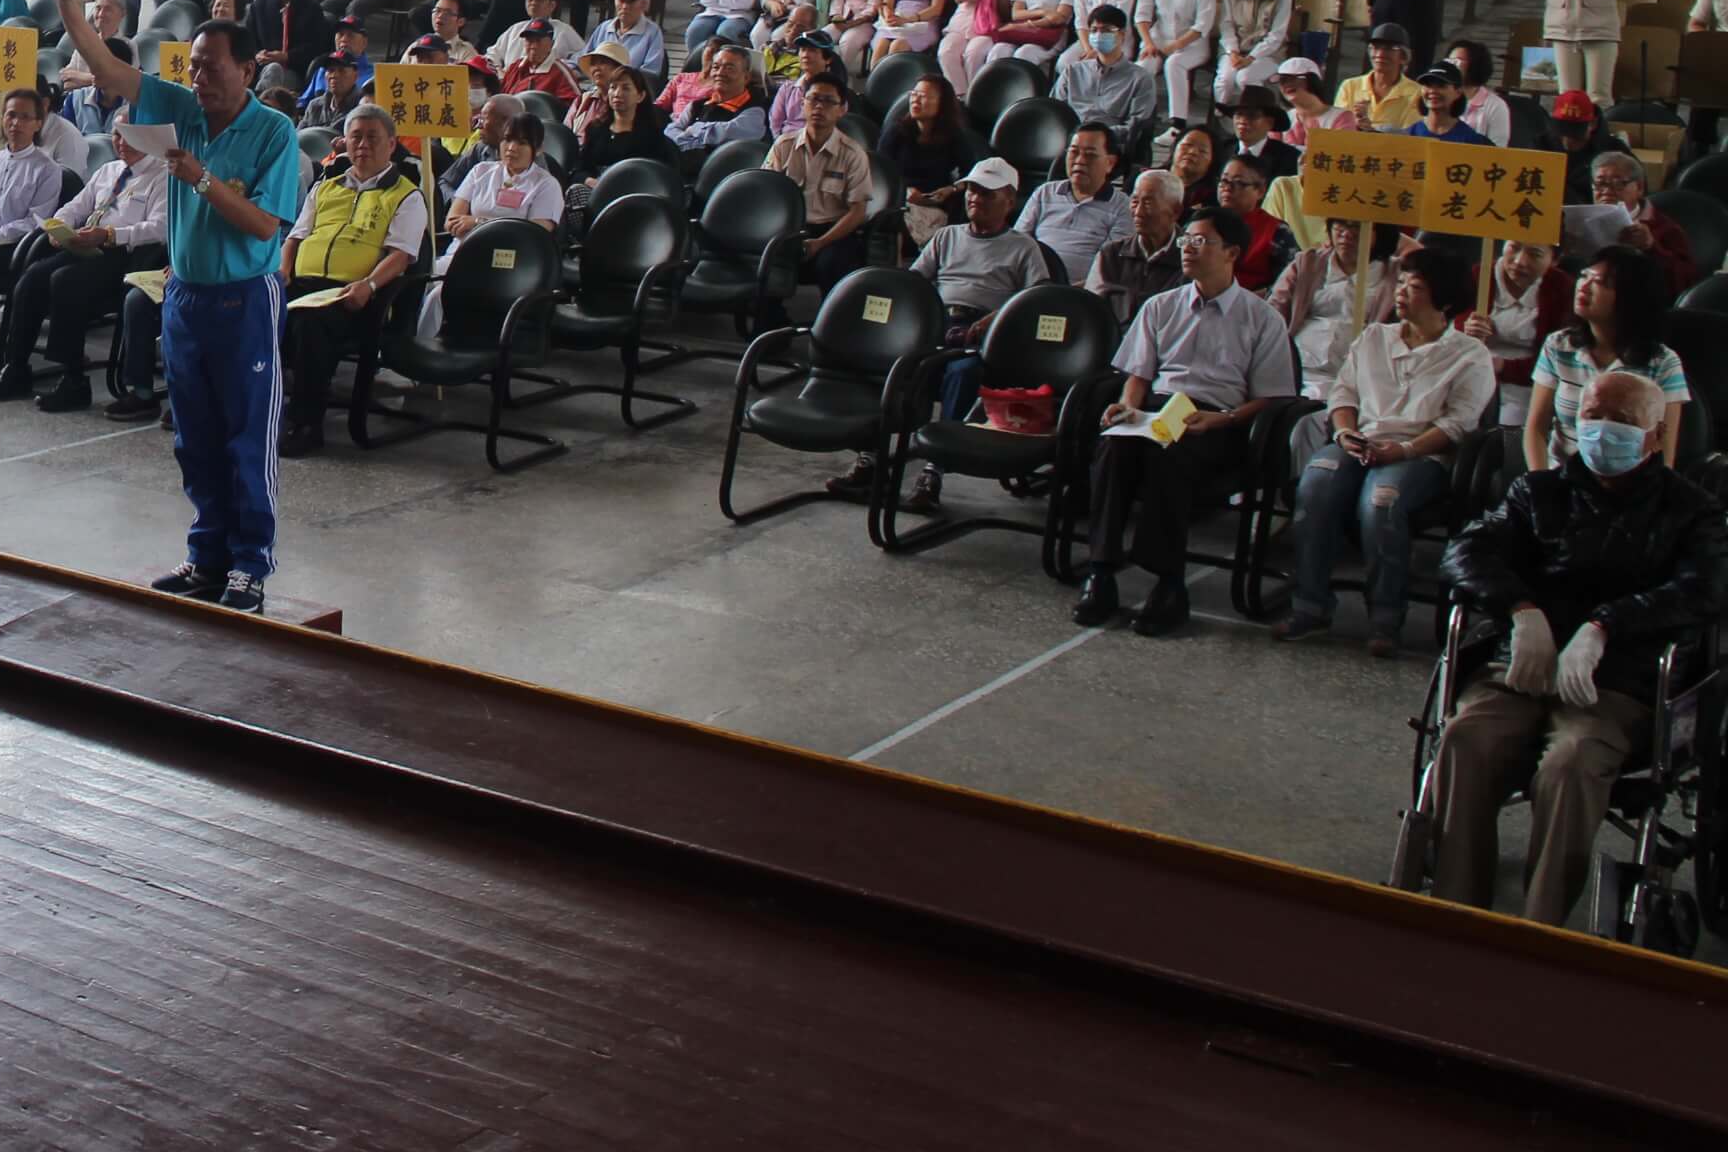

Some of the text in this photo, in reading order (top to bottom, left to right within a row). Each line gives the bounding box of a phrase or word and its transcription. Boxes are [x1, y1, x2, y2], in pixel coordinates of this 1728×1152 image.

[390, 77, 454, 101] 台中市
[391, 101, 458, 128] 榮服處
[1312, 152, 1425, 180] 衛福部中區
[1446, 162, 1546, 196] 田中鎮
[1321, 183, 1414, 212] 老人之家
[1440, 191, 1543, 229] 老人會
